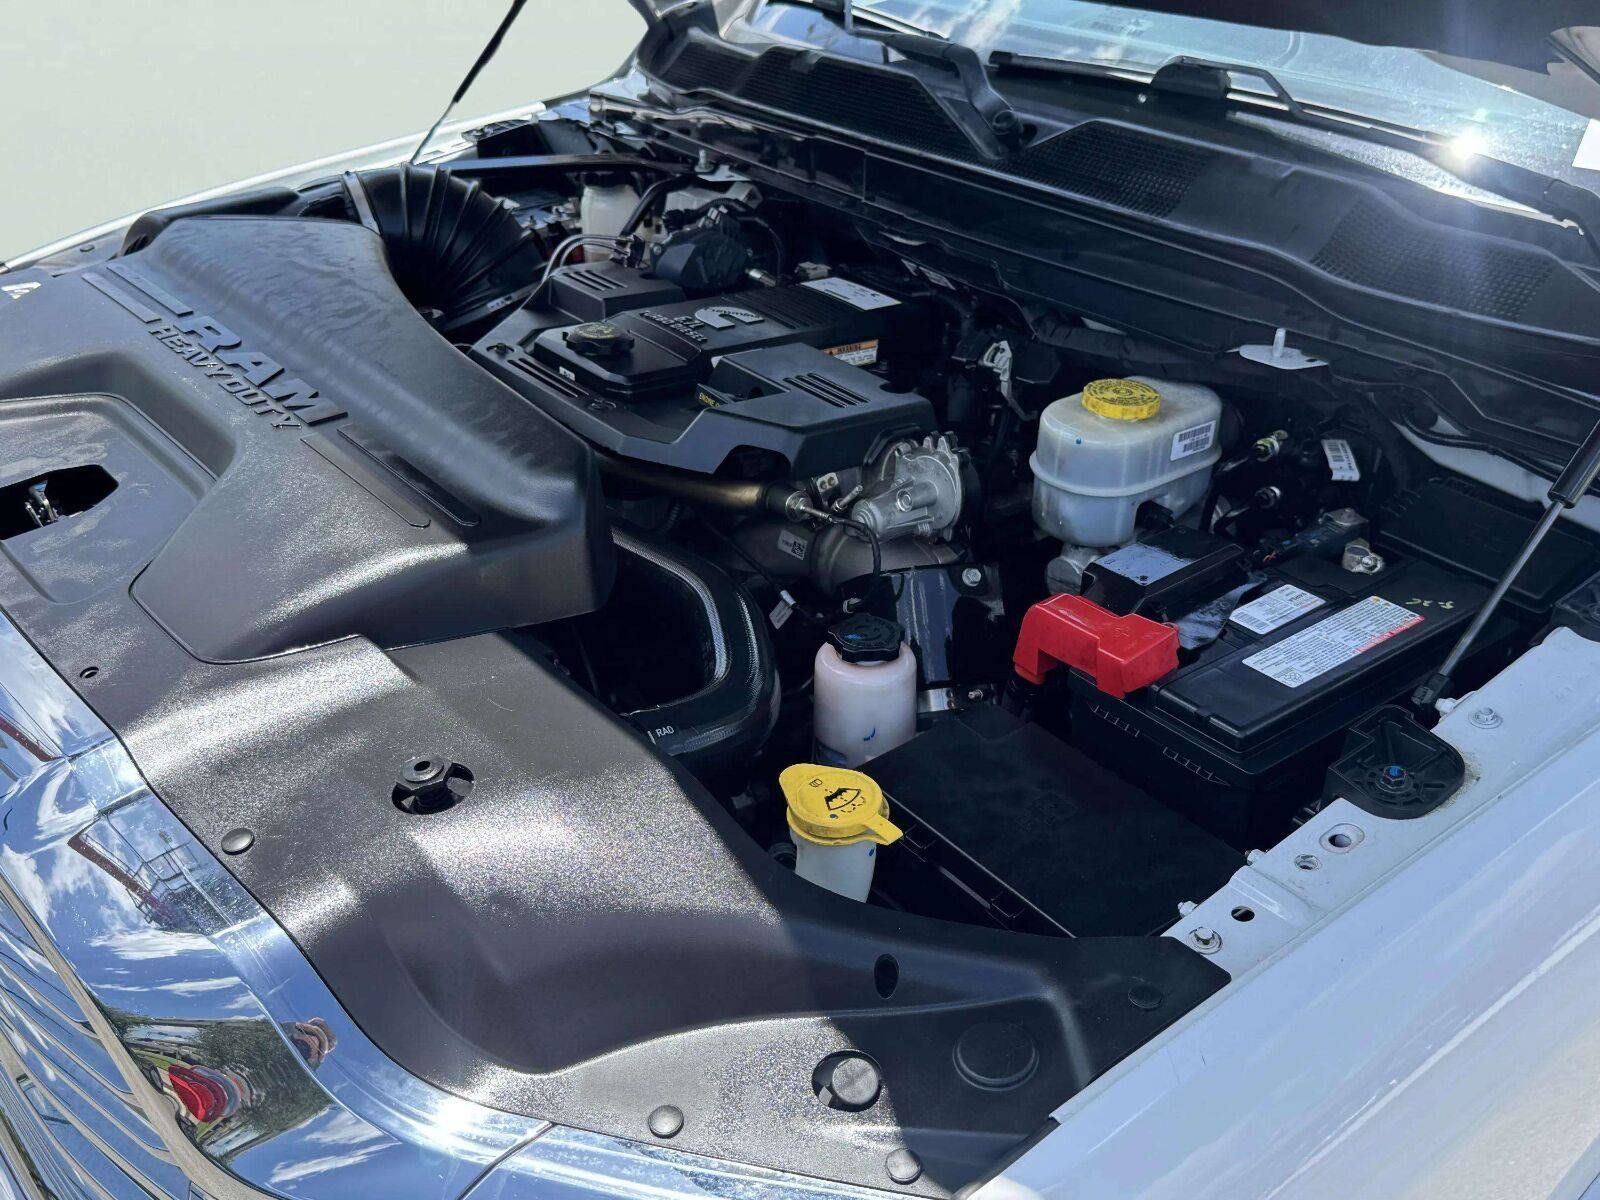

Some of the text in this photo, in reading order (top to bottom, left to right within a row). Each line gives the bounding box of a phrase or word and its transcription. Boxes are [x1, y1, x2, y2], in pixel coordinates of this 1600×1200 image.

[147, 325, 302, 428] HEAVY DUTY
[172, 315, 349, 426] RAM
[655, 725, 675, 737] RAD
